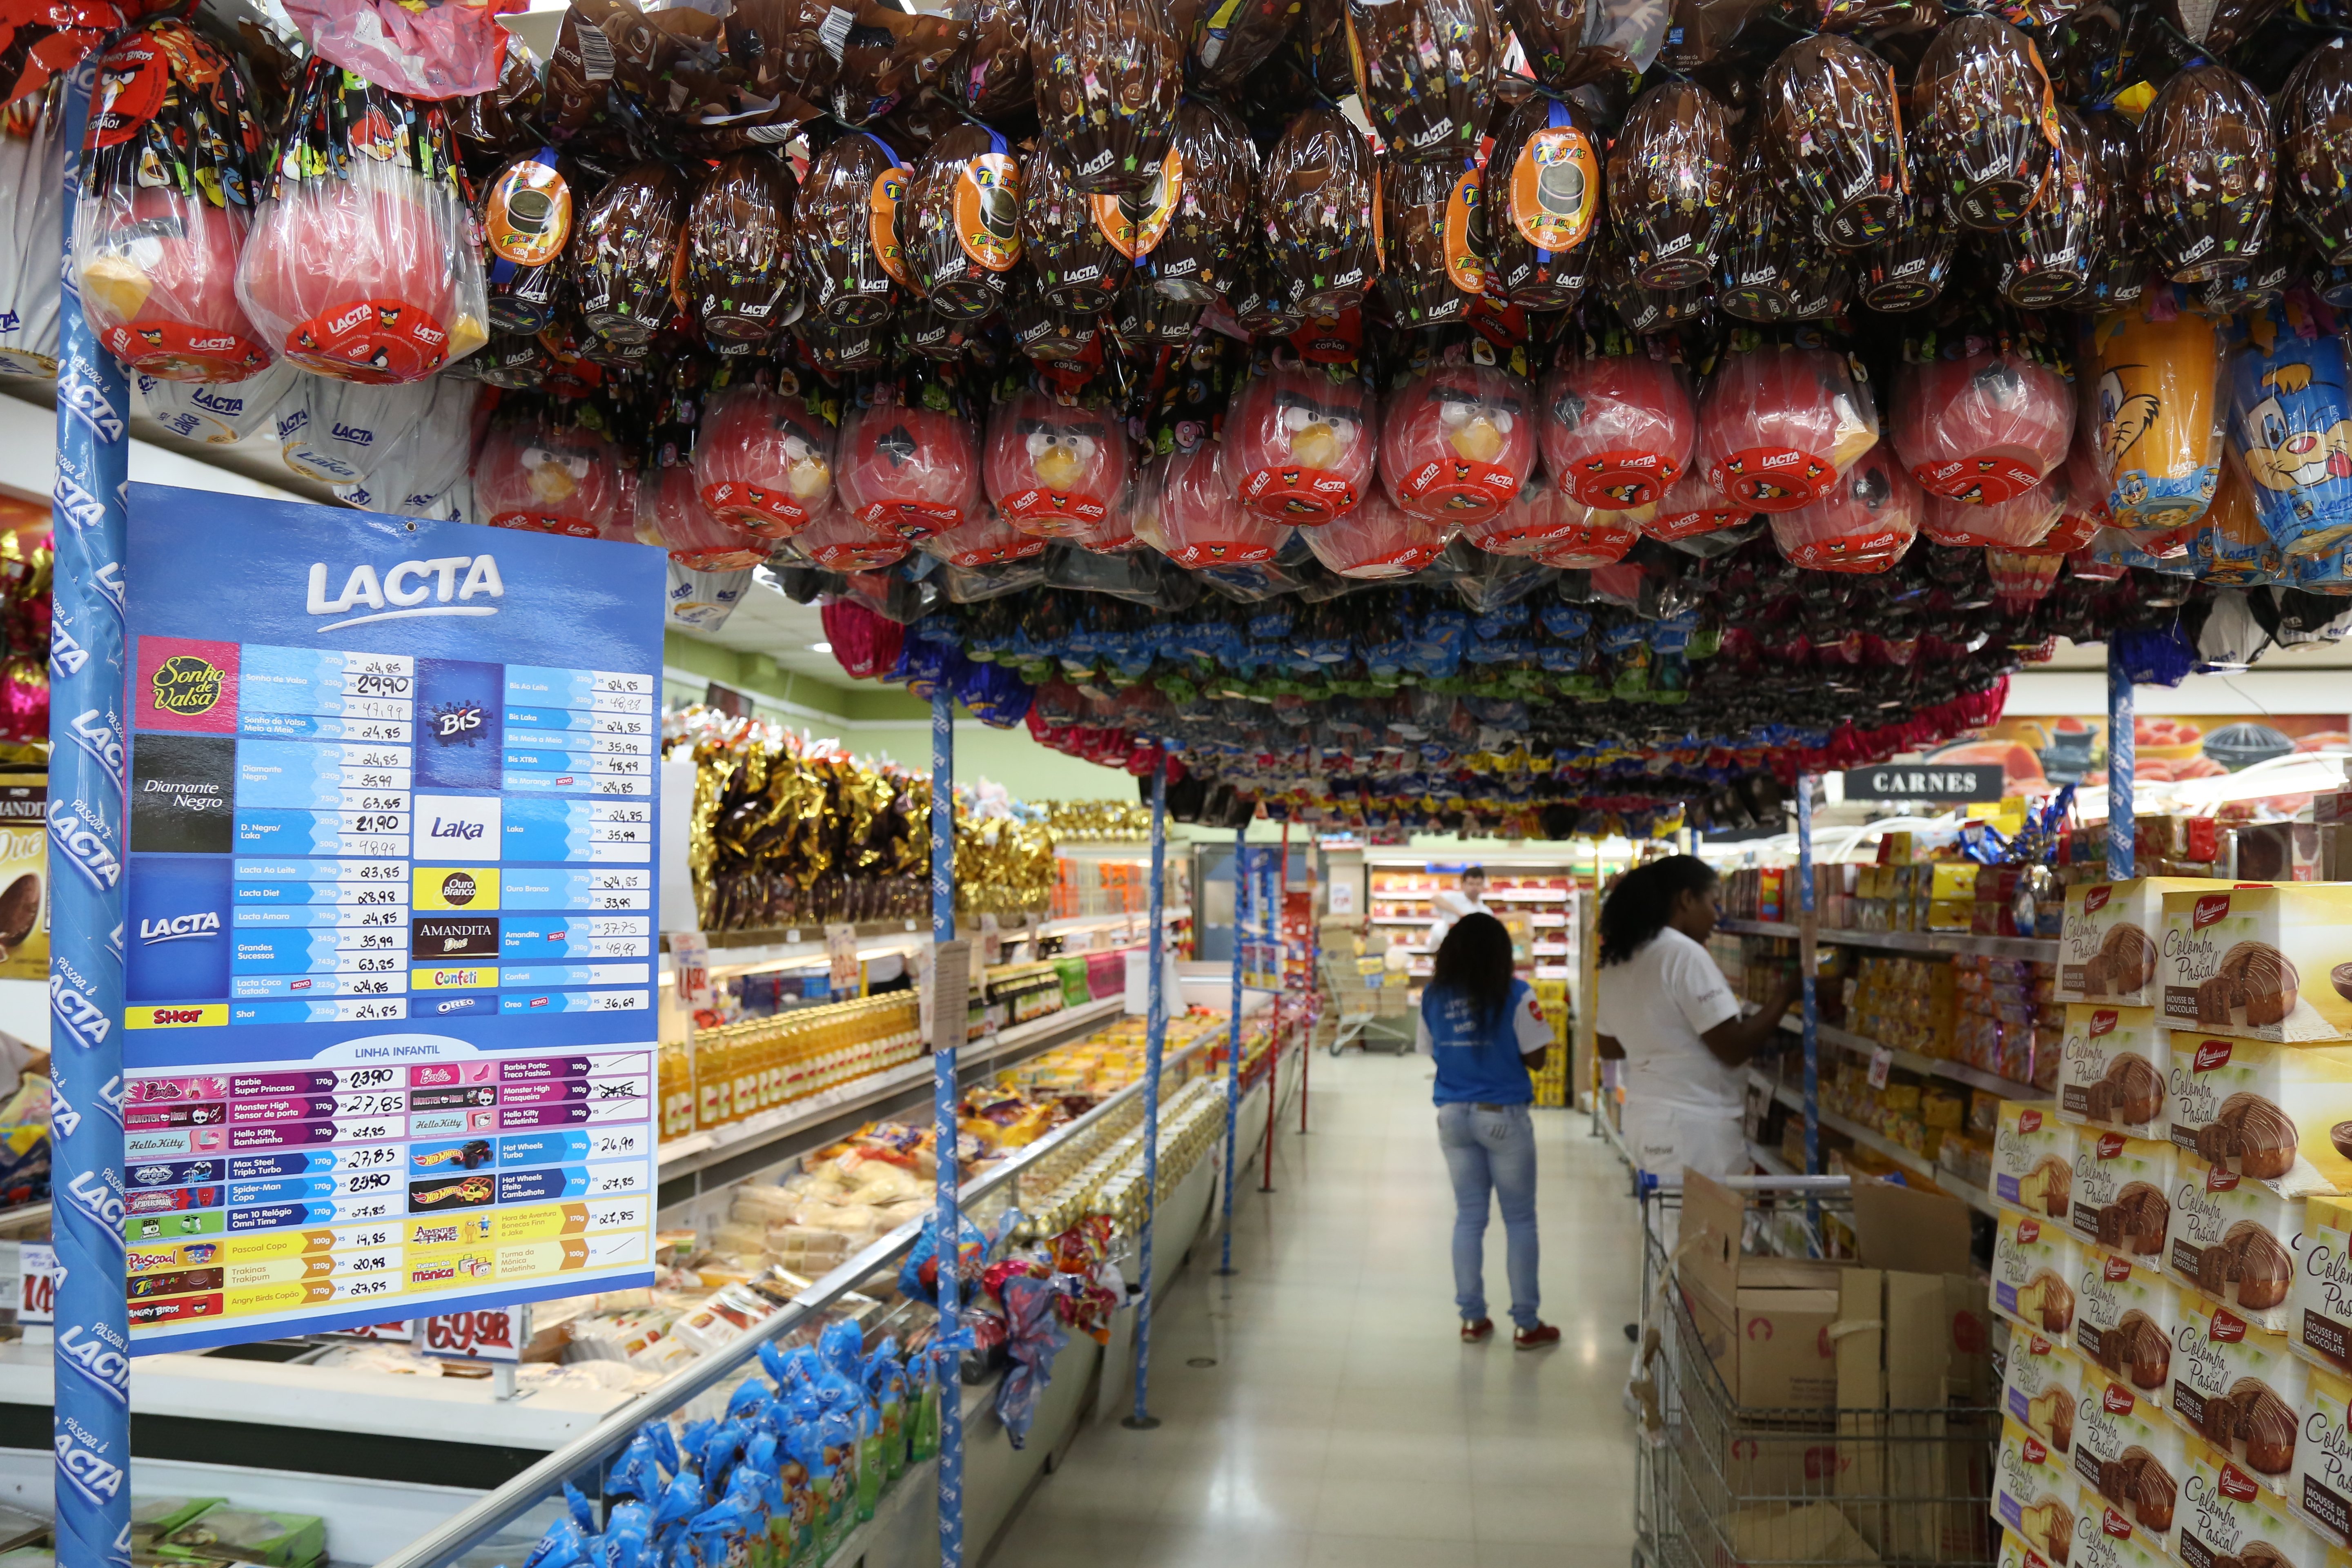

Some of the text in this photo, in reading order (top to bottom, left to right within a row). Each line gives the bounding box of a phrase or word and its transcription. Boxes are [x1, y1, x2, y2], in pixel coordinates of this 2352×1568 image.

[126, 50, 155, 61] BIRDS
[1414, 117, 1453, 145] LACTA
[1077, 149, 1114, 174] LACTA
[1974, 156, 2011, 181] LACTA
[1844, 169, 1873, 198] LACTA
[1542, 230, 1557, 242] 120g
[1658, 234, 1691, 256] LACTA
[2179, 236, 2214, 261] LACTA
[1165, 258, 1196, 272] LACTA
[1892, 258, 1925, 274] LACTA
[1064, 265, 1099, 280] LACTA
[1334, 268, 1363, 283] LACTA
[1742, 266, 1776, 283] LACTA
[328, 304, 372, 334] LACTA
[189, 336, 236, 346] LACTA
[192, 387, 243, 410] LACTA
[1620, 455, 1656, 466] LACTA
[1762, 452, 1799, 466] LACTA
[1414, 463, 1439, 490] LACTA
[1484, 472, 1513, 486] LACTA
[2007, 469, 2038, 483] LACTA
[1314, 478, 1345, 490] LACTA
[306, 554, 506, 615] LACTA
[152, 656, 225, 686] Sonho
[366, 662, 401, 675] 24,85
[196, 682, 214, 693] de
[358, 675, 408, 697] 29,90
[152, 687, 213, 710] Valsa
[608, 742, 638, 754] 35,99
[145, 780, 218, 796] Diamante
[1872, 773, 1977, 792] CARNES
[174, 794, 223, 811] Negro
[363, 797, 401, 809] 63,85
[609, 810, 642, 822] 24,85
[356, 815, 398, 833] 21,90
[431, 817, 484, 840] Laka
[361, 866, 399, 879] 23,85
[449, 879, 474, 889] Ouro
[443, 886, 476, 898] Branco
[2196, 901, 2227, 921] Bauducco
[140, 912, 220, 939] LACTA
[421, 924, 492, 937] AMANDITA
[360, 935, 393, 950] 35,99
[443, 938, 468, 952] Due
[2164, 928, 2214, 956] Colomba
[359, 958, 394, 972] 63,85
[2176, 951, 2218, 986] Pascal
[293, 980, 310, 989] NOVO
[434, 970, 477, 986] Confeti
[438, 999, 474, 1013] OREO
[2167, 996, 2196, 1005] MOUSSE DE
[356, 1004, 397, 1018] 24,85
[2167, 1005, 2198, 1014] CHOCOLATE
[153, 1009, 203, 1025] SHOT
[355, 1045, 440, 1058] LINHA INFANTIL
[420, 1068, 451, 1084] Barbie
[234, 1085, 295, 1096] Super Princesa
[270, 1101, 289, 1111] High
[347, 1096, 403, 1115] 27,85
[276, 1109, 298, 1118] porta
[234, 1128, 276, 1138] Hello Kitty
[234, 1137, 283, 1146] Banheirinha
[234, 1158, 274, 1168] Max Steel
[348, 1149, 395, 1168] 27,85
[233, 1167, 282, 1177] Triplo Turbo
[516, 1174, 542, 1182] Wheels
[233, 1183, 281, 1194] Spider-Man
[602, 1177, 635, 1191] 27,85
[233, 1194, 255, 1203] Copo
[502, 1189, 545, 1198] Cambalhota
[232, 1212, 249, 1220] Ben
[262, 1207, 292, 1218] Relógio
[232, 1220, 255, 1229] Omni
[232, 1242, 287, 1254] Pascoal Copo
[313, 1237, 330, 1245] 100g
[126, 1250, 176, 1269] Pascoal
[501, 1257, 527, 1266] Mônica
[232, 1266, 266, 1275] Trakinas
[501, 1264, 536, 1274] Maletinha
[232, 1274, 270, 1284] Trakipum
[232, 1292, 299, 1306] Angry Birds Copão
[2213, 1313, 2243, 1333] Bauducco
[2306, 1320, 2342, 1344] MOUSSE DE
[2178, 1327, 2225, 1370] Colomba
[2305, 1331, 2345, 1357] CHOCOLATE
[2189, 1358, 2229, 1395] Pascal
[2176, 1399, 2203, 1424] CHOCOLATE
